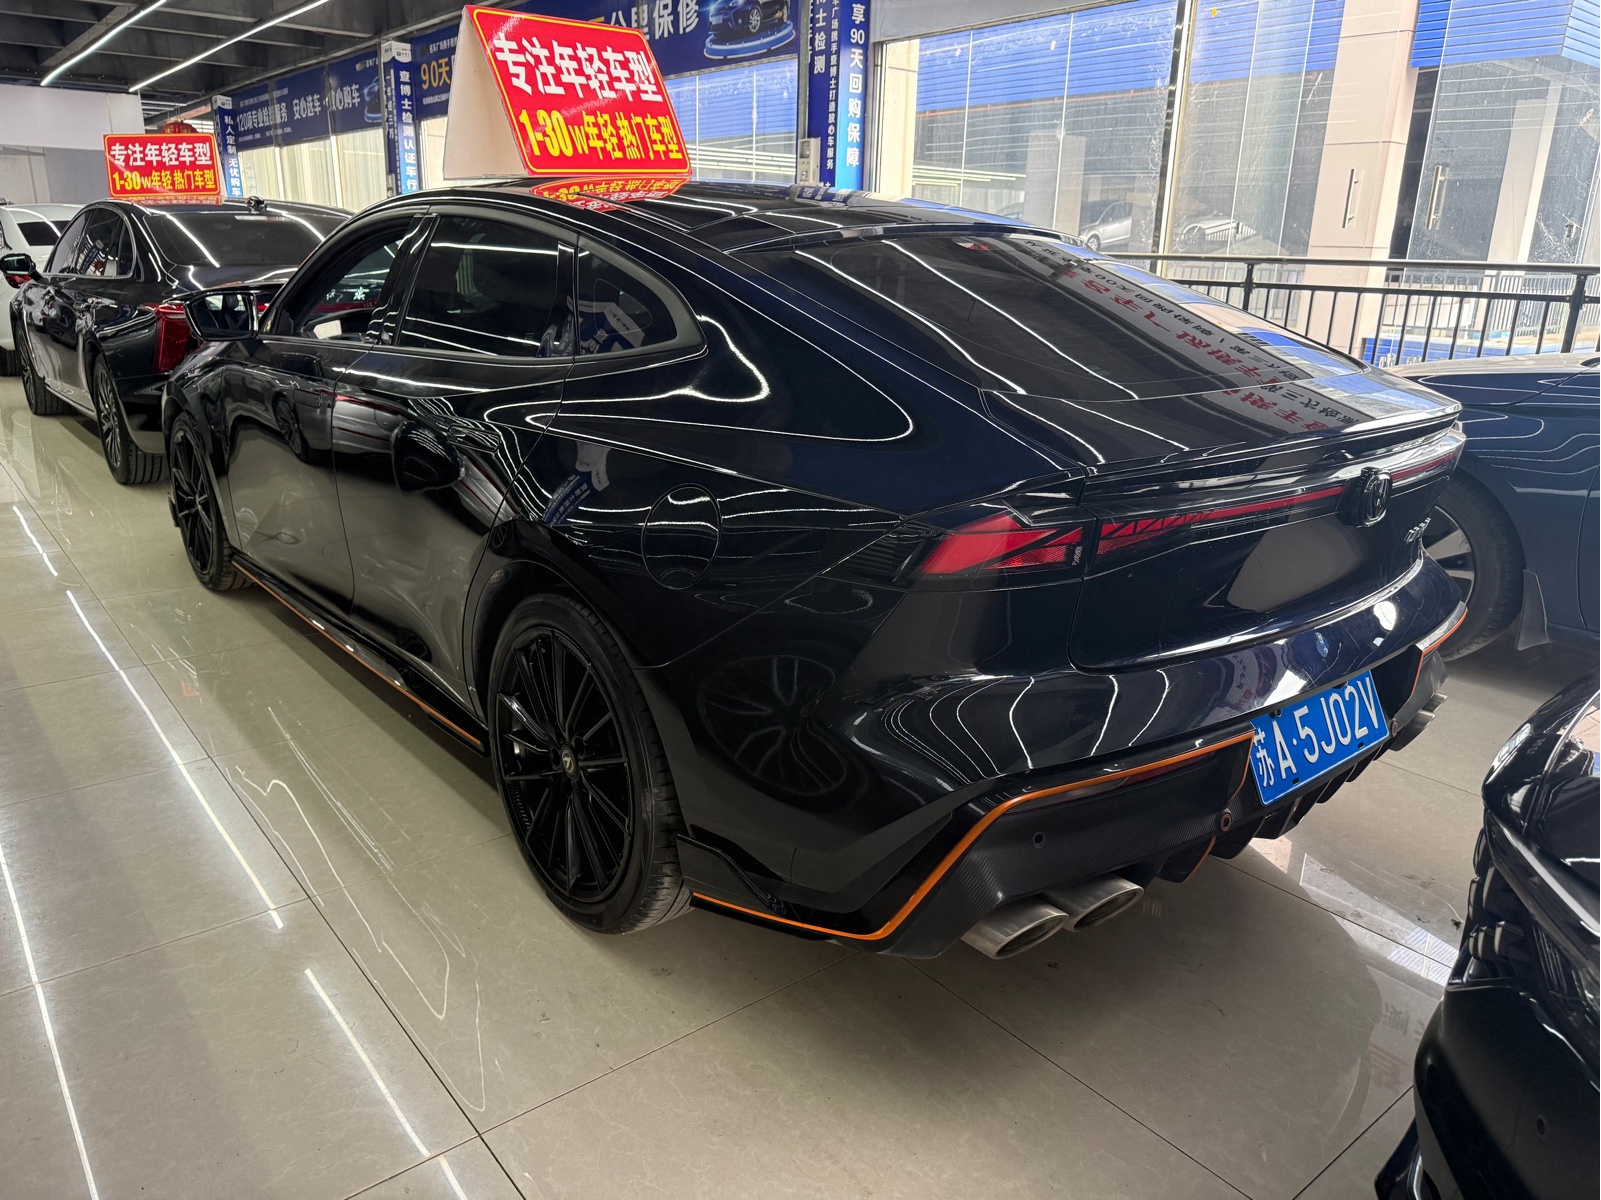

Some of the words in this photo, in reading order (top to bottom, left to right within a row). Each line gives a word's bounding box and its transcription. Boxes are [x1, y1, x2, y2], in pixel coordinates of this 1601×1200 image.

[421, 54, 456, 90] 90天
[493, 31, 664, 103] 专注年轻车型
[813, 0, 828, 75] 士检测
[845, 3, 866, 168] 享90天回购保障
[110, 142, 213, 168] 专注年轻车型
[399, 70, 418, 191] 查博士检测认证车行
[1253, 676, 1379, 788] 苏A·5J02V
